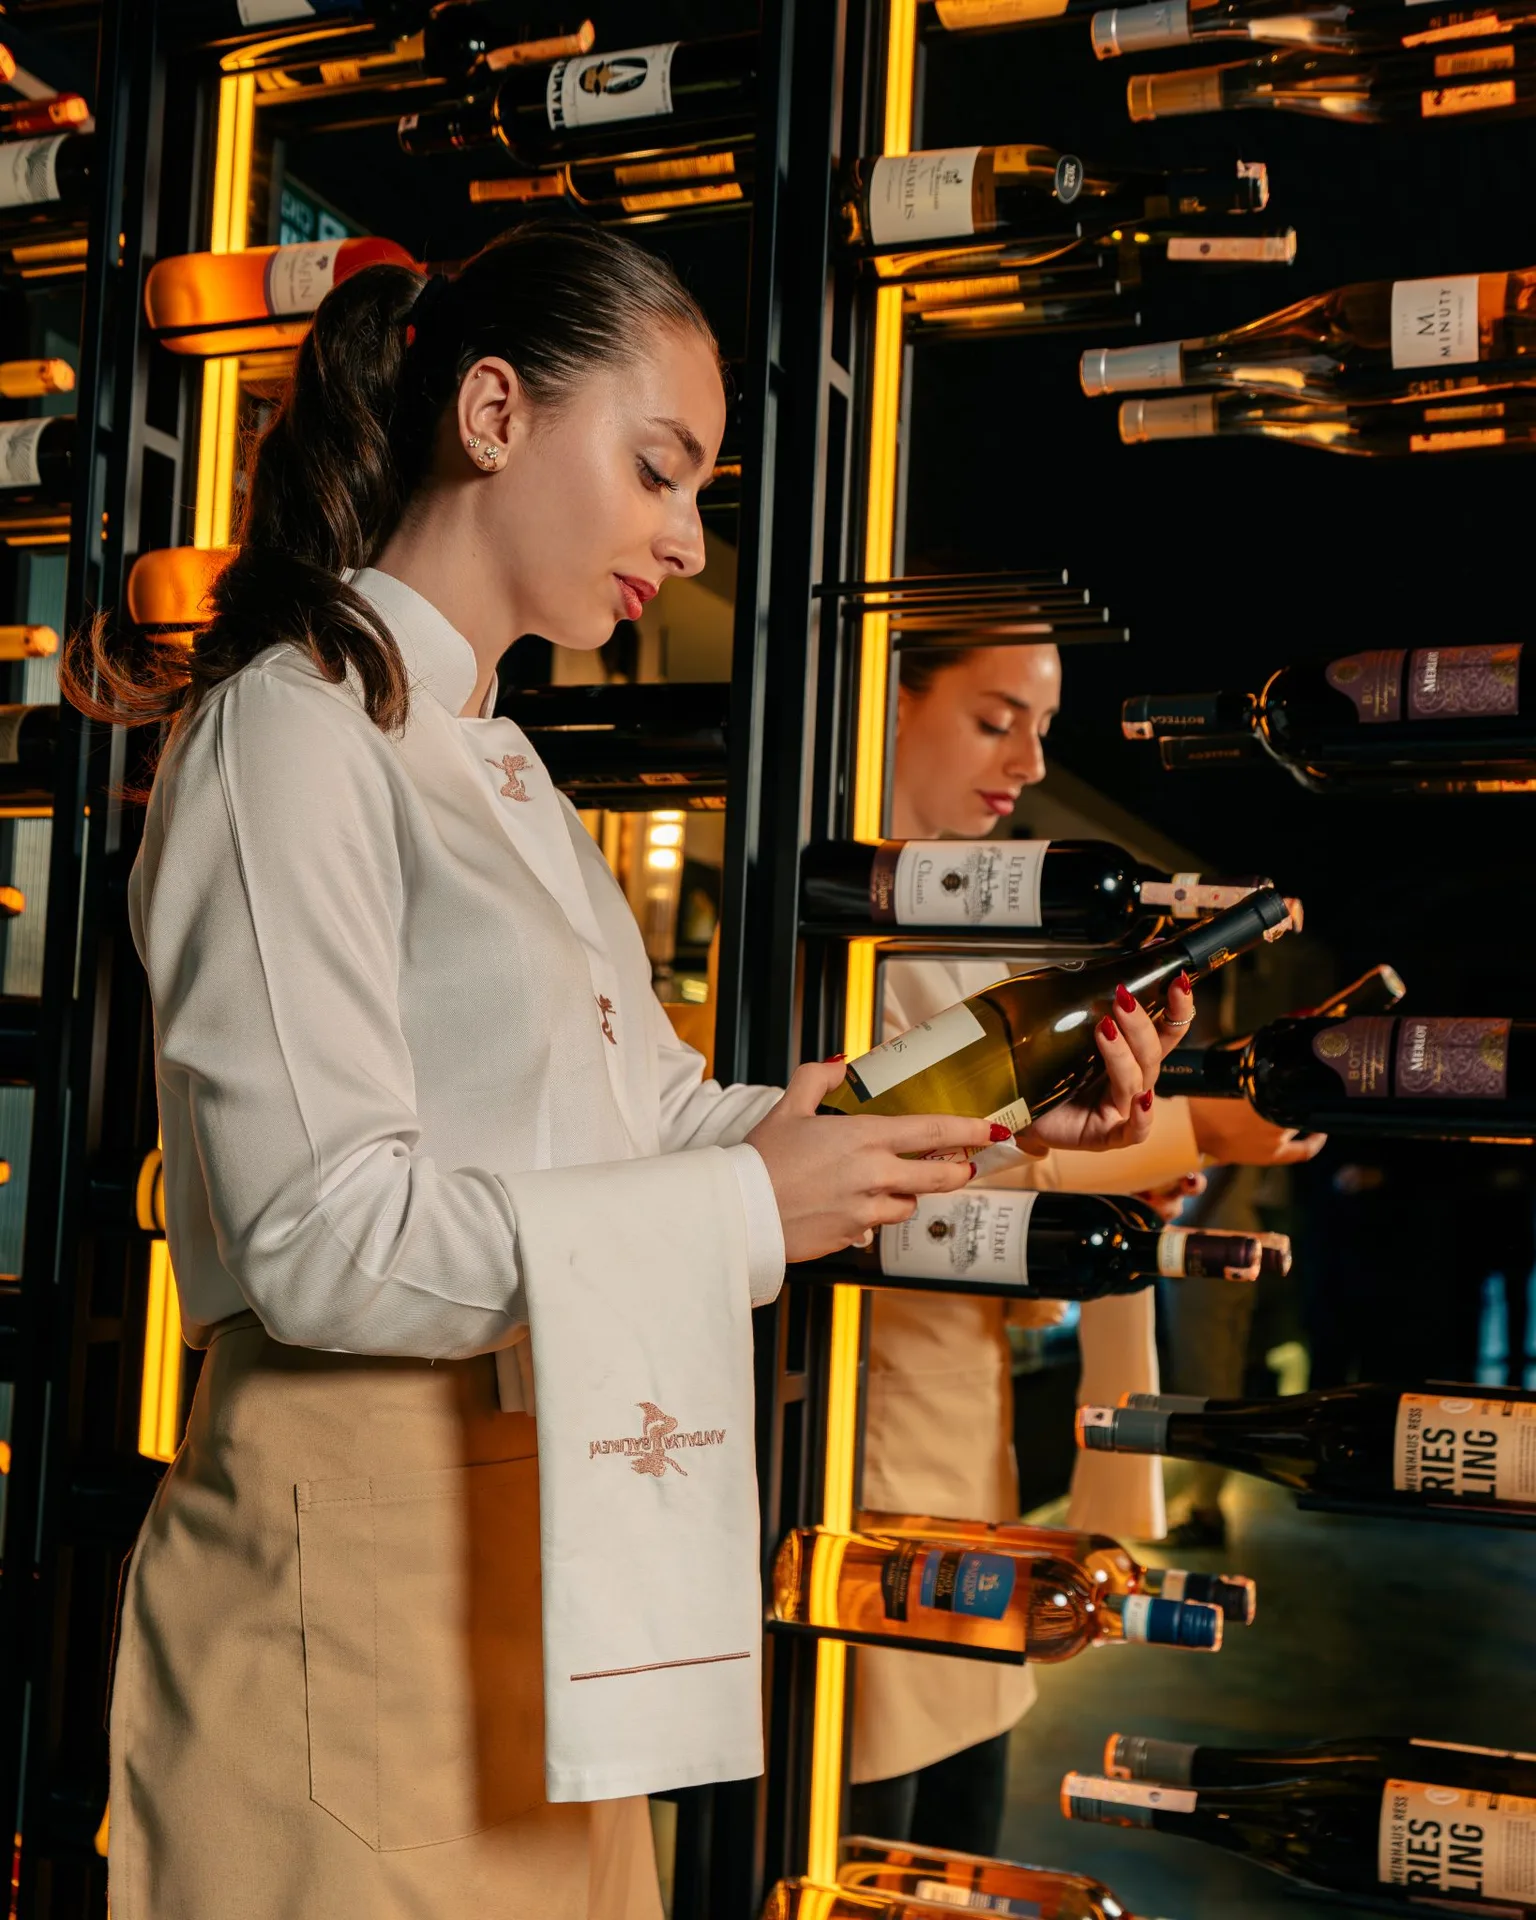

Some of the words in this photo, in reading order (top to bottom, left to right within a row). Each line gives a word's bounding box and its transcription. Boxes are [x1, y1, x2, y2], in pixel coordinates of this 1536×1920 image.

[1439, 288, 1452, 357] MINUTY
[1007, 871, 1023, 912] TERRE
[1410, 1024, 1428, 1072] MERLOT
[663, 1429, 727, 1450] ANTALYA
[1407, 1407, 1424, 1431] RESS
[1421, 1427, 1456, 1494] RIES
[1461, 1429, 1498, 1499] LING
[1392, 1795, 1410, 1822] RESS
[1406, 1818, 1442, 1889] RIES
[1448, 1823, 1485, 1897] LING
